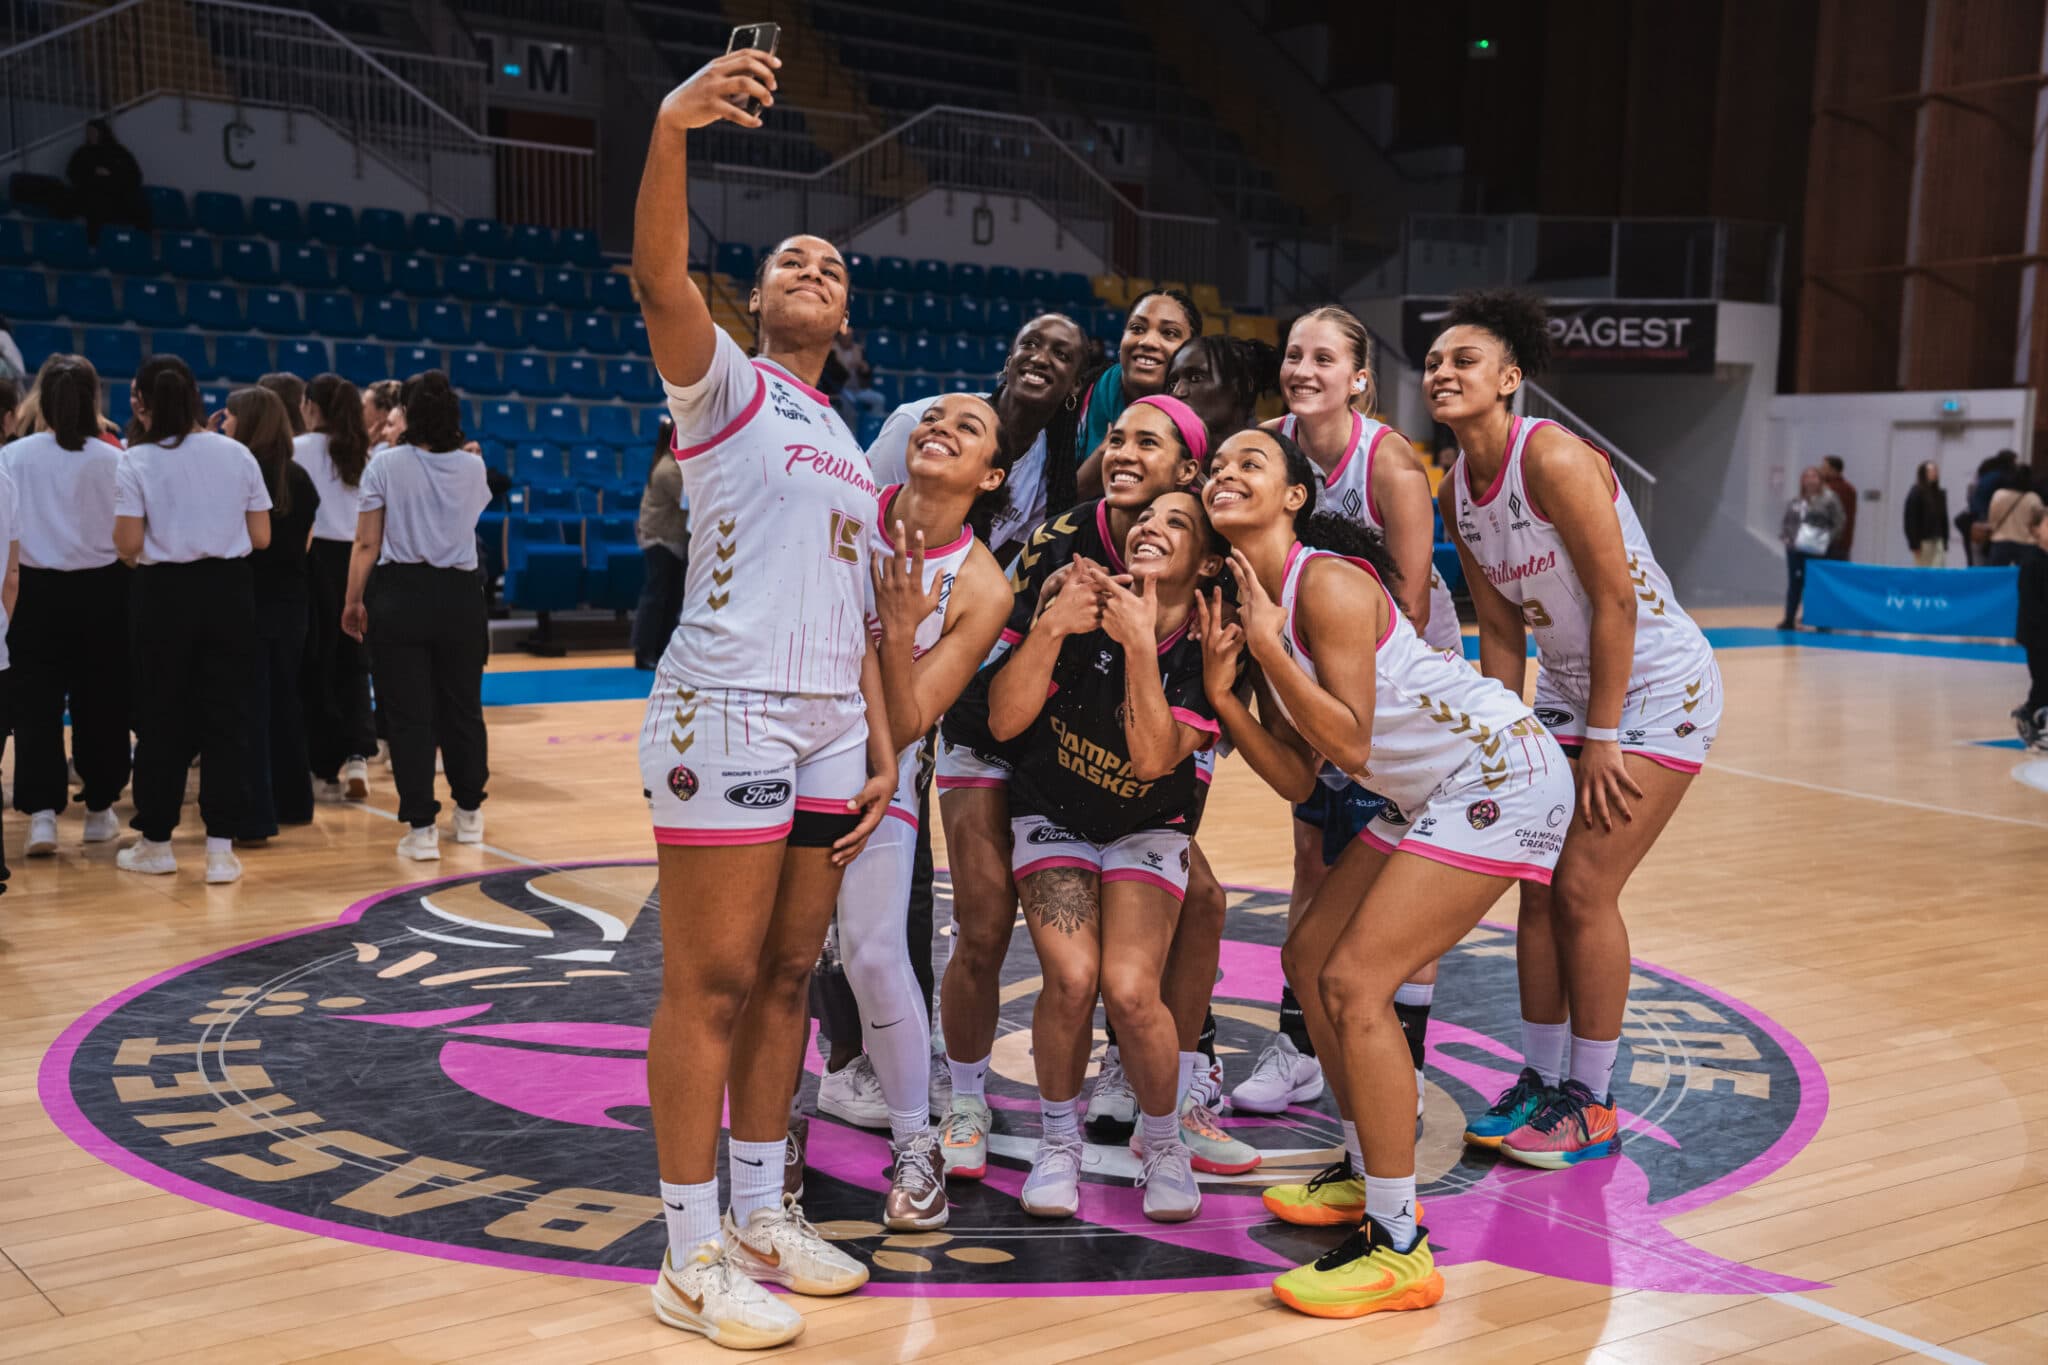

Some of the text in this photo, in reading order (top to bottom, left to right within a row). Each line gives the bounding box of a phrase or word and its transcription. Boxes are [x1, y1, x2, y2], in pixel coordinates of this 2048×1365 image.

[527, 45, 569, 95] M
[223, 122, 256, 171] C
[828, 508, 865, 565] 15
[1484, 550, 1556, 585] étillantes
[743, 783, 786, 804] Ford
[1058, 746, 1155, 798] BASKET
[112, 1036, 672, 1251] BASKET
